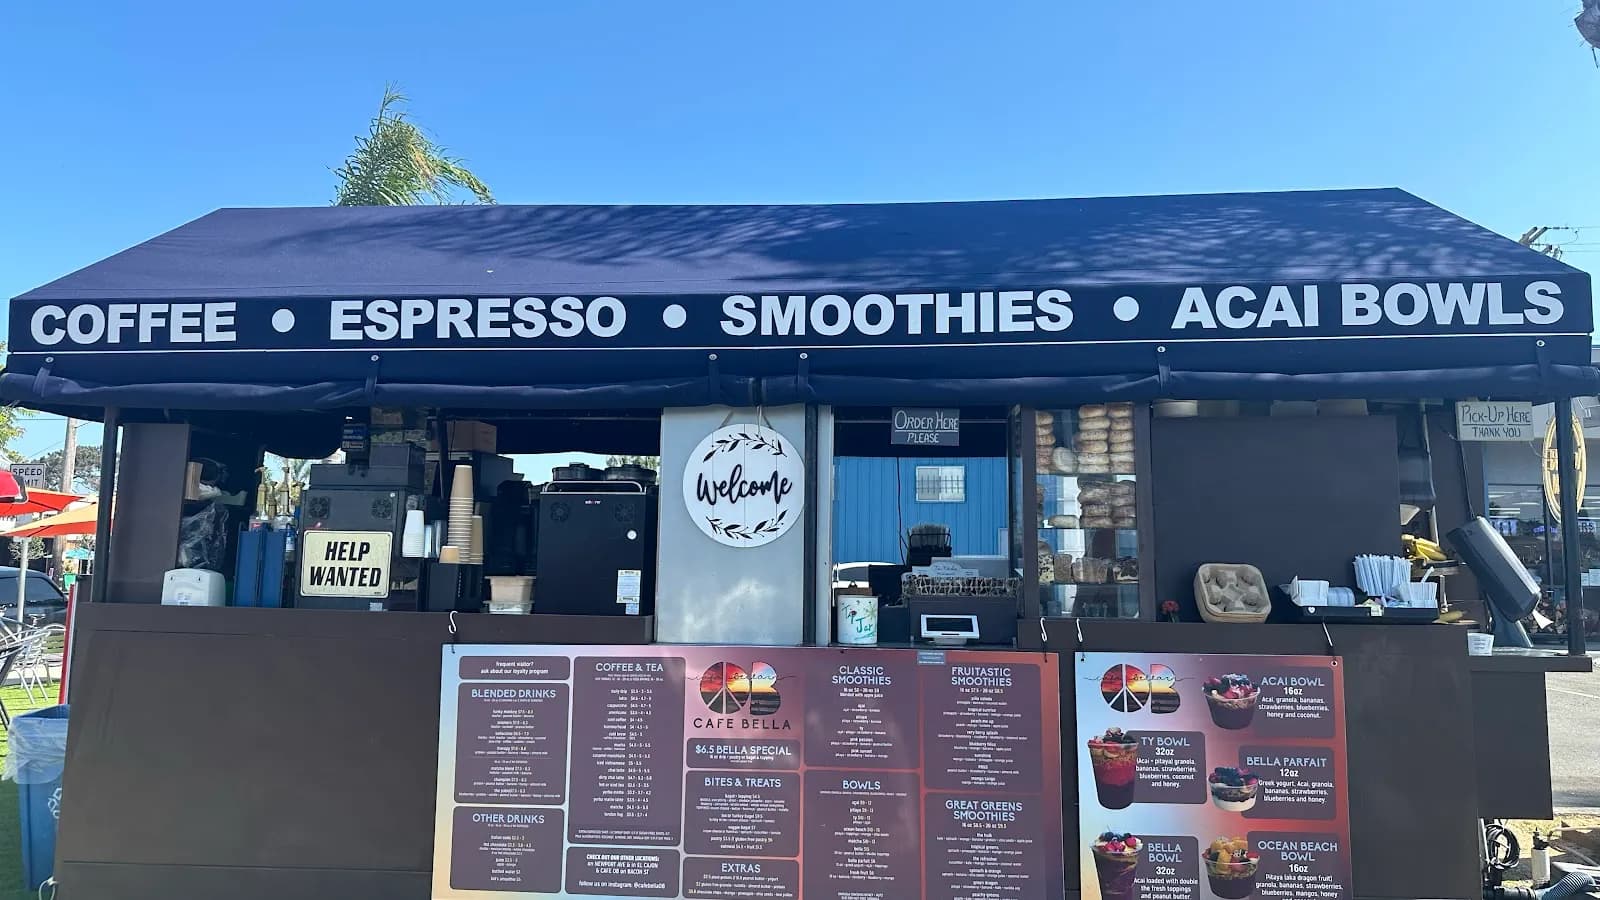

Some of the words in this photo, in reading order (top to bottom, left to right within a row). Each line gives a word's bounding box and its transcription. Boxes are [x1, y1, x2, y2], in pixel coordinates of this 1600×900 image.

[31, 302, 236, 344] COFFEE
[331, 297, 626, 340] ESPRESSO
[721, 288, 1073, 335] SMOOTHIES
[1172, 285, 1318, 328] ACAI
[1342, 279, 1563, 325] BOWLS
[1472, 427, 1501, 438] THANK
[1503, 427, 1520, 438] YOU
[907, 433, 940, 443] PLEASE
[13, 468, 42, 476] SPEED
[325, 541, 370, 561] HELP
[310, 566, 382, 587] WANTED
[595, 663, 633, 672] COFFEE
[635, 663, 643, 672] &
[646, 663, 664, 672] TEA
[839, 666, 884, 675] CLASSIC
[951, 666, 1011, 677] FRUITASTIC
[831, 675, 892, 686] SMOOTHIES
[951, 677, 1012, 687] SMOOTHIES
[1261, 677, 1288, 686] ACAI
[1290, 677, 1325, 687] BOWL
[471, 689, 516, 698] BLENDED
[519, 689, 556, 698] DRINKS
[1283, 687, 1303, 695] 16oz
[693, 718, 734, 729] CAFE
[742, 719, 791, 730] BELLA
[1141, 737, 1154, 746] TY
[1157, 737, 1190, 746] BOWL
[695, 744, 714, 754] $6.5
[716, 745, 748, 754] BELLA
[750, 746, 792, 756] SPECIAL
[1155, 747, 1174, 756] 32oz
[1246, 757, 1281, 766] BELLA
[1283, 757, 1327, 767] PARFAIT
[1280, 768, 1299, 777] 12oz
[704, 777, 733, 787] BITES
[734, 778, 743, 787] &
[745, 778, 781, 788] TREATS
[842, 780, 881, 790] BOWLS
[945, 800, 979, 810] GREAT
[981, 801, 1023, 811] GREENS
[472, 813, 504, 823] OTHER
[507, 814, 545, 824] DRINKS
[953, 811, 1015, 821] SMOOTHIES
[1148, 843, 1182, 852] BELLA
[1258, 841, 1297, 850] OCEAN
[1300, 842, 1338, 852] BEACH
[1148, 853, 1182, 863] BOWL
[1281, 852, 1316, 861] BOWL
[721, 863, 761, 873] EXTRAS
[1156, 866, 1176, 875] 32oz
[1289, 864, 1308, 873] 16oz
[1265, 873, 1283, 881] Pitaya
[1297, 874, 1317, 882] dragon
[1321, 891, 1338, 899] honey
